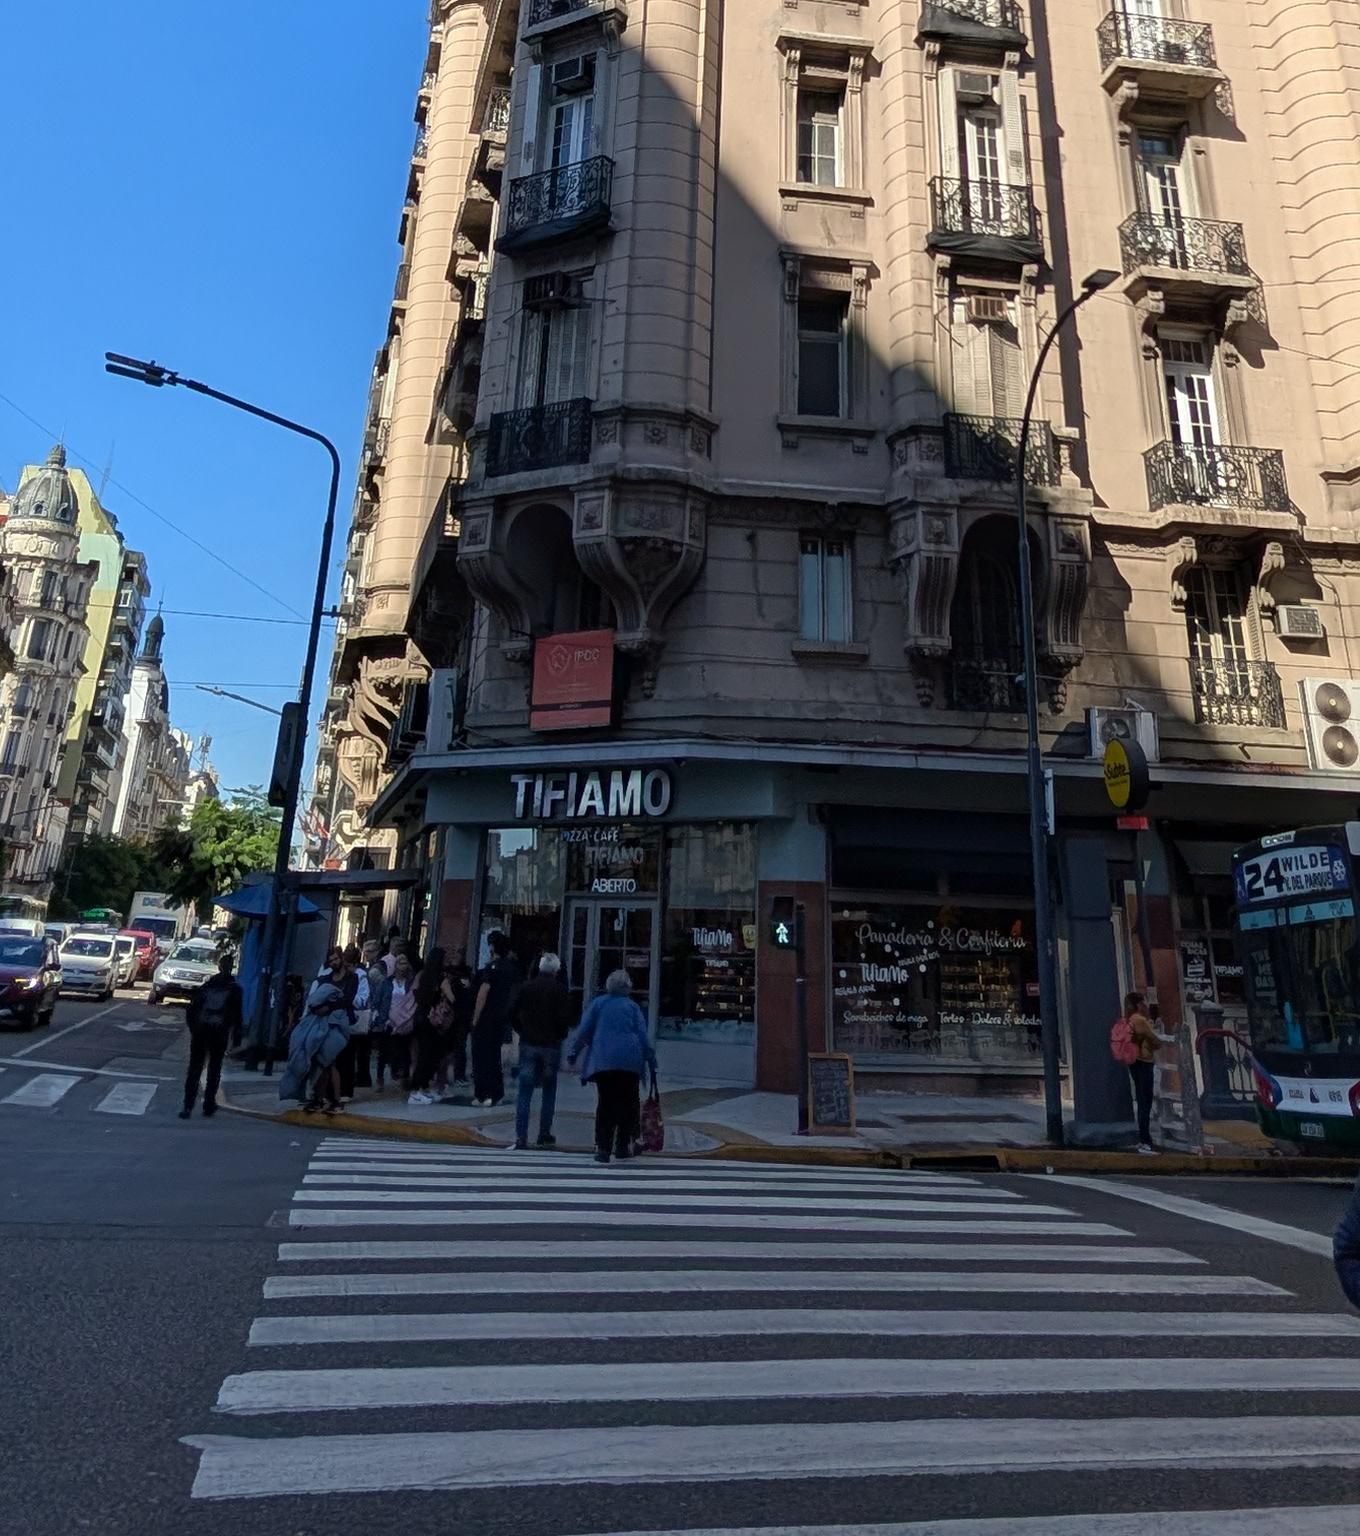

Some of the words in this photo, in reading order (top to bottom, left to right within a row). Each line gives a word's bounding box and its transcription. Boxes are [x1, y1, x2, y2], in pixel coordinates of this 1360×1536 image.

[510, 768, 671, 819] TIFIAMO
[1244, 857, 1285, 897] 24
[1281, 851, 1329, 873] WILDE
